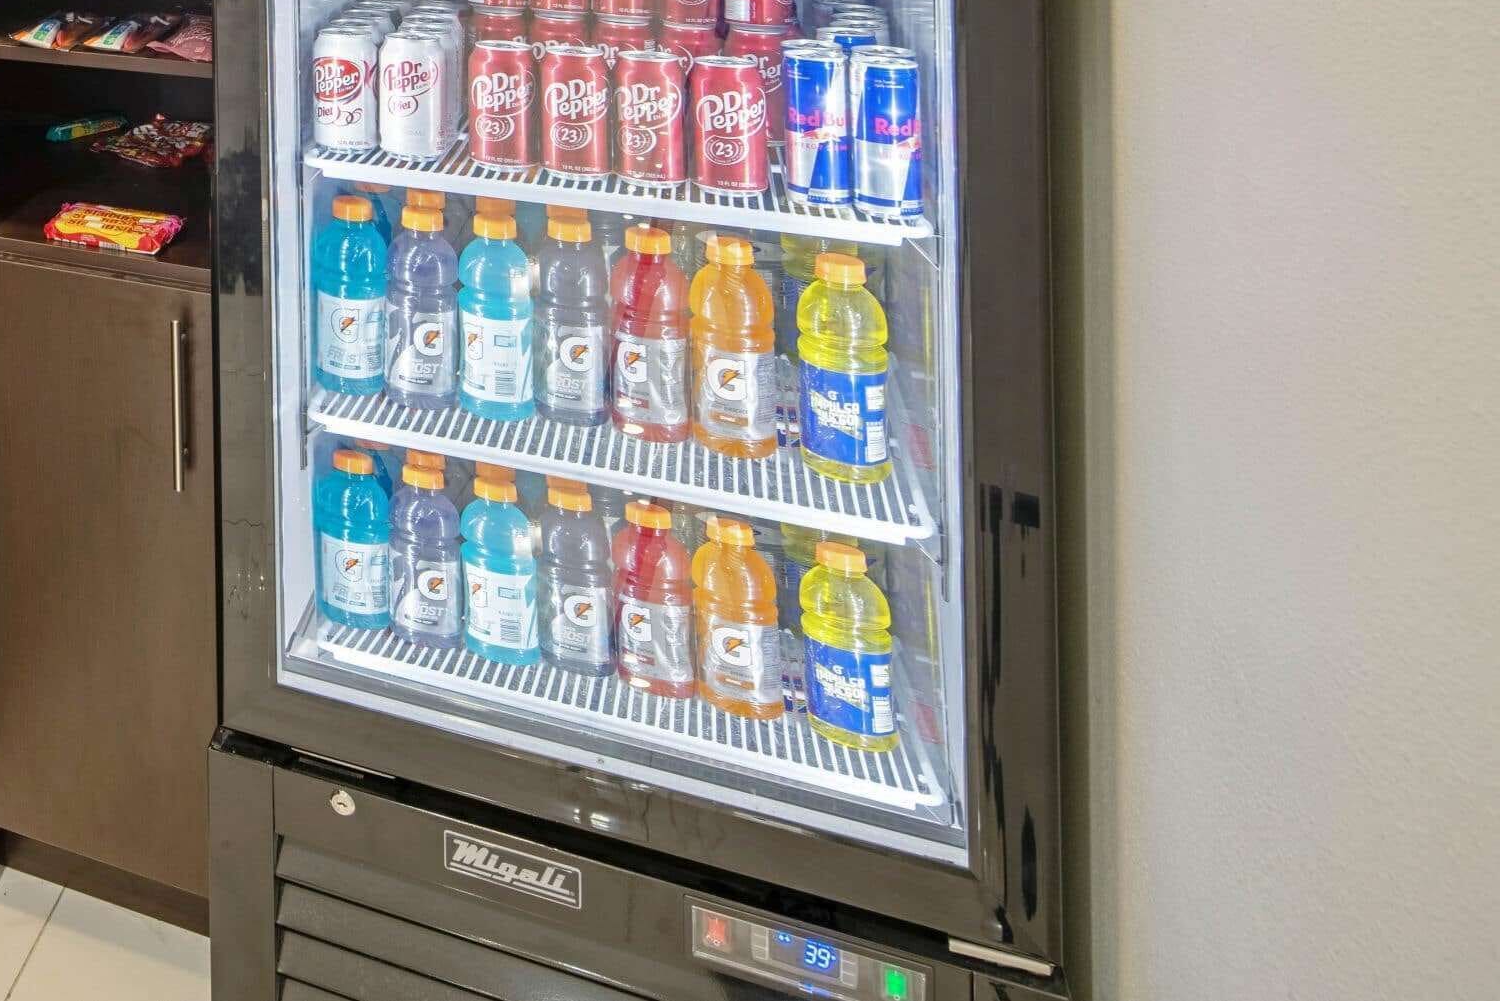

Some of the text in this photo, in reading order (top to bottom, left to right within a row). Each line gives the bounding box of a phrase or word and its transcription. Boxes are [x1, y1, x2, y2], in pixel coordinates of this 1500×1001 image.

[325, 63, 344, 79] Dr
[402, 60, 422, 77] Dr
[315, 66, 359, 94] Pepper
[491, 73, 519, 91] Dr
[568, 79, 596, 98] Dr
[547, 83, 608, 119] Pepper
[631, 83, 660, 103] Dr
[317, 106, 333, 118] Diet
[699, 95, 765, 133] Pepper
[788, 107, 820, 127] Red
[484, 121, 500, 135] 23
[561, 128, 578, 142] 23
[875, 118, 912, 136] Red
[714, 142, 733, 158] 23
[452, 838, 575, 898] Migali
